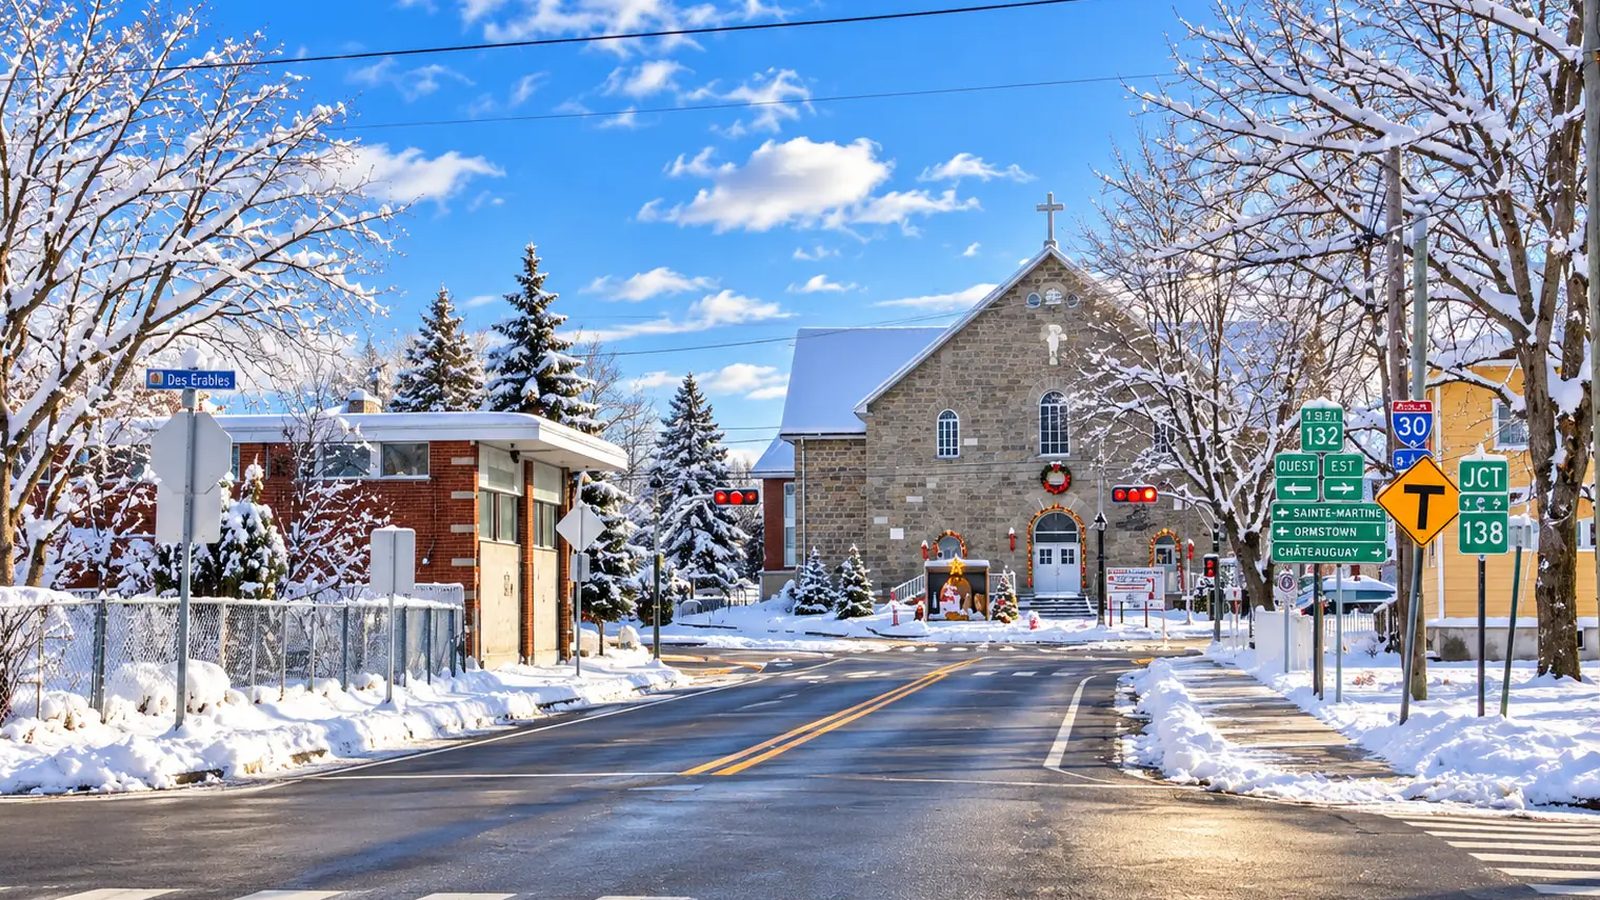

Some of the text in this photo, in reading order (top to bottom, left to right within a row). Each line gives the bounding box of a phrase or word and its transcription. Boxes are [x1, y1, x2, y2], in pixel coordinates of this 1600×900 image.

[167, 373, 188, 386] Des
[1398, 416, 1427, 436] 30
[1306, 426, 1339, 446] 132
[1279, 460, 1315, 472] OUEST
[1331, 461, 1355, 472] EST
[1463, 467, 1503, 488] JCT
[1293, 507, 1382, 519] SAINTE-MARTINE
[1294, 526, 1357, 537] ORMSTOWN
[1463, 520, 1504, 545] 138
